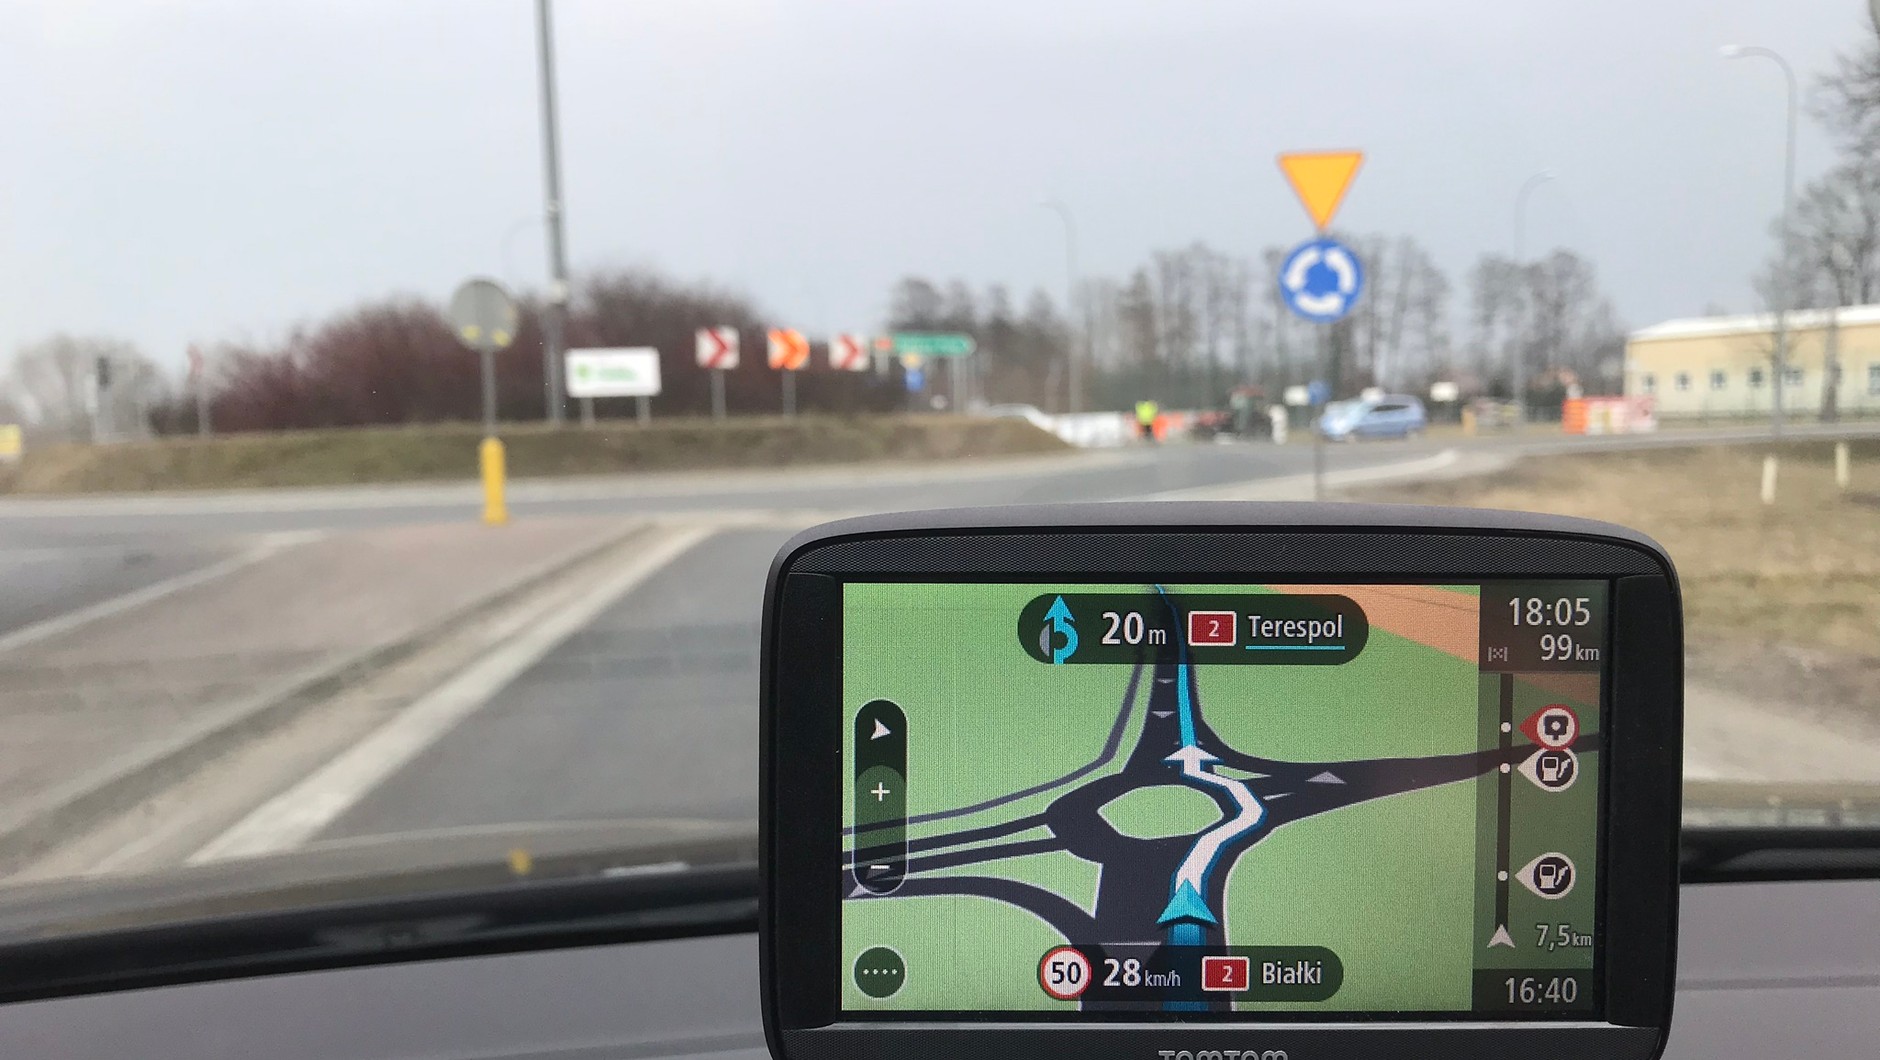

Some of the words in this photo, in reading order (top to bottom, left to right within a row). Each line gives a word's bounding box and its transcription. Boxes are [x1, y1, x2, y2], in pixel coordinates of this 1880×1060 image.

[1508, 597, 1591, 626] 18:05
[1101, 611, 1143, 645] 20
[1149, 628, 1167, 645] m
[1208, 620, 1220, 637] 2
[1248, 614, 1343, 643] Terespol
[1540, 634, 1573, 661] 99
[1575, 643, 1600, 661] km
[1536, 924, 1570, 951] 7,5
[1051, 961, 1082, 985] 50
[1103, 958, 1142, 987] 28
[1145, 969, 1181, 988] km/h
[1222, 965, 1233, 982] 2
[1262, 961, 1321, 984] Białki
[1505, 977, 1578, 1004] 16:40
